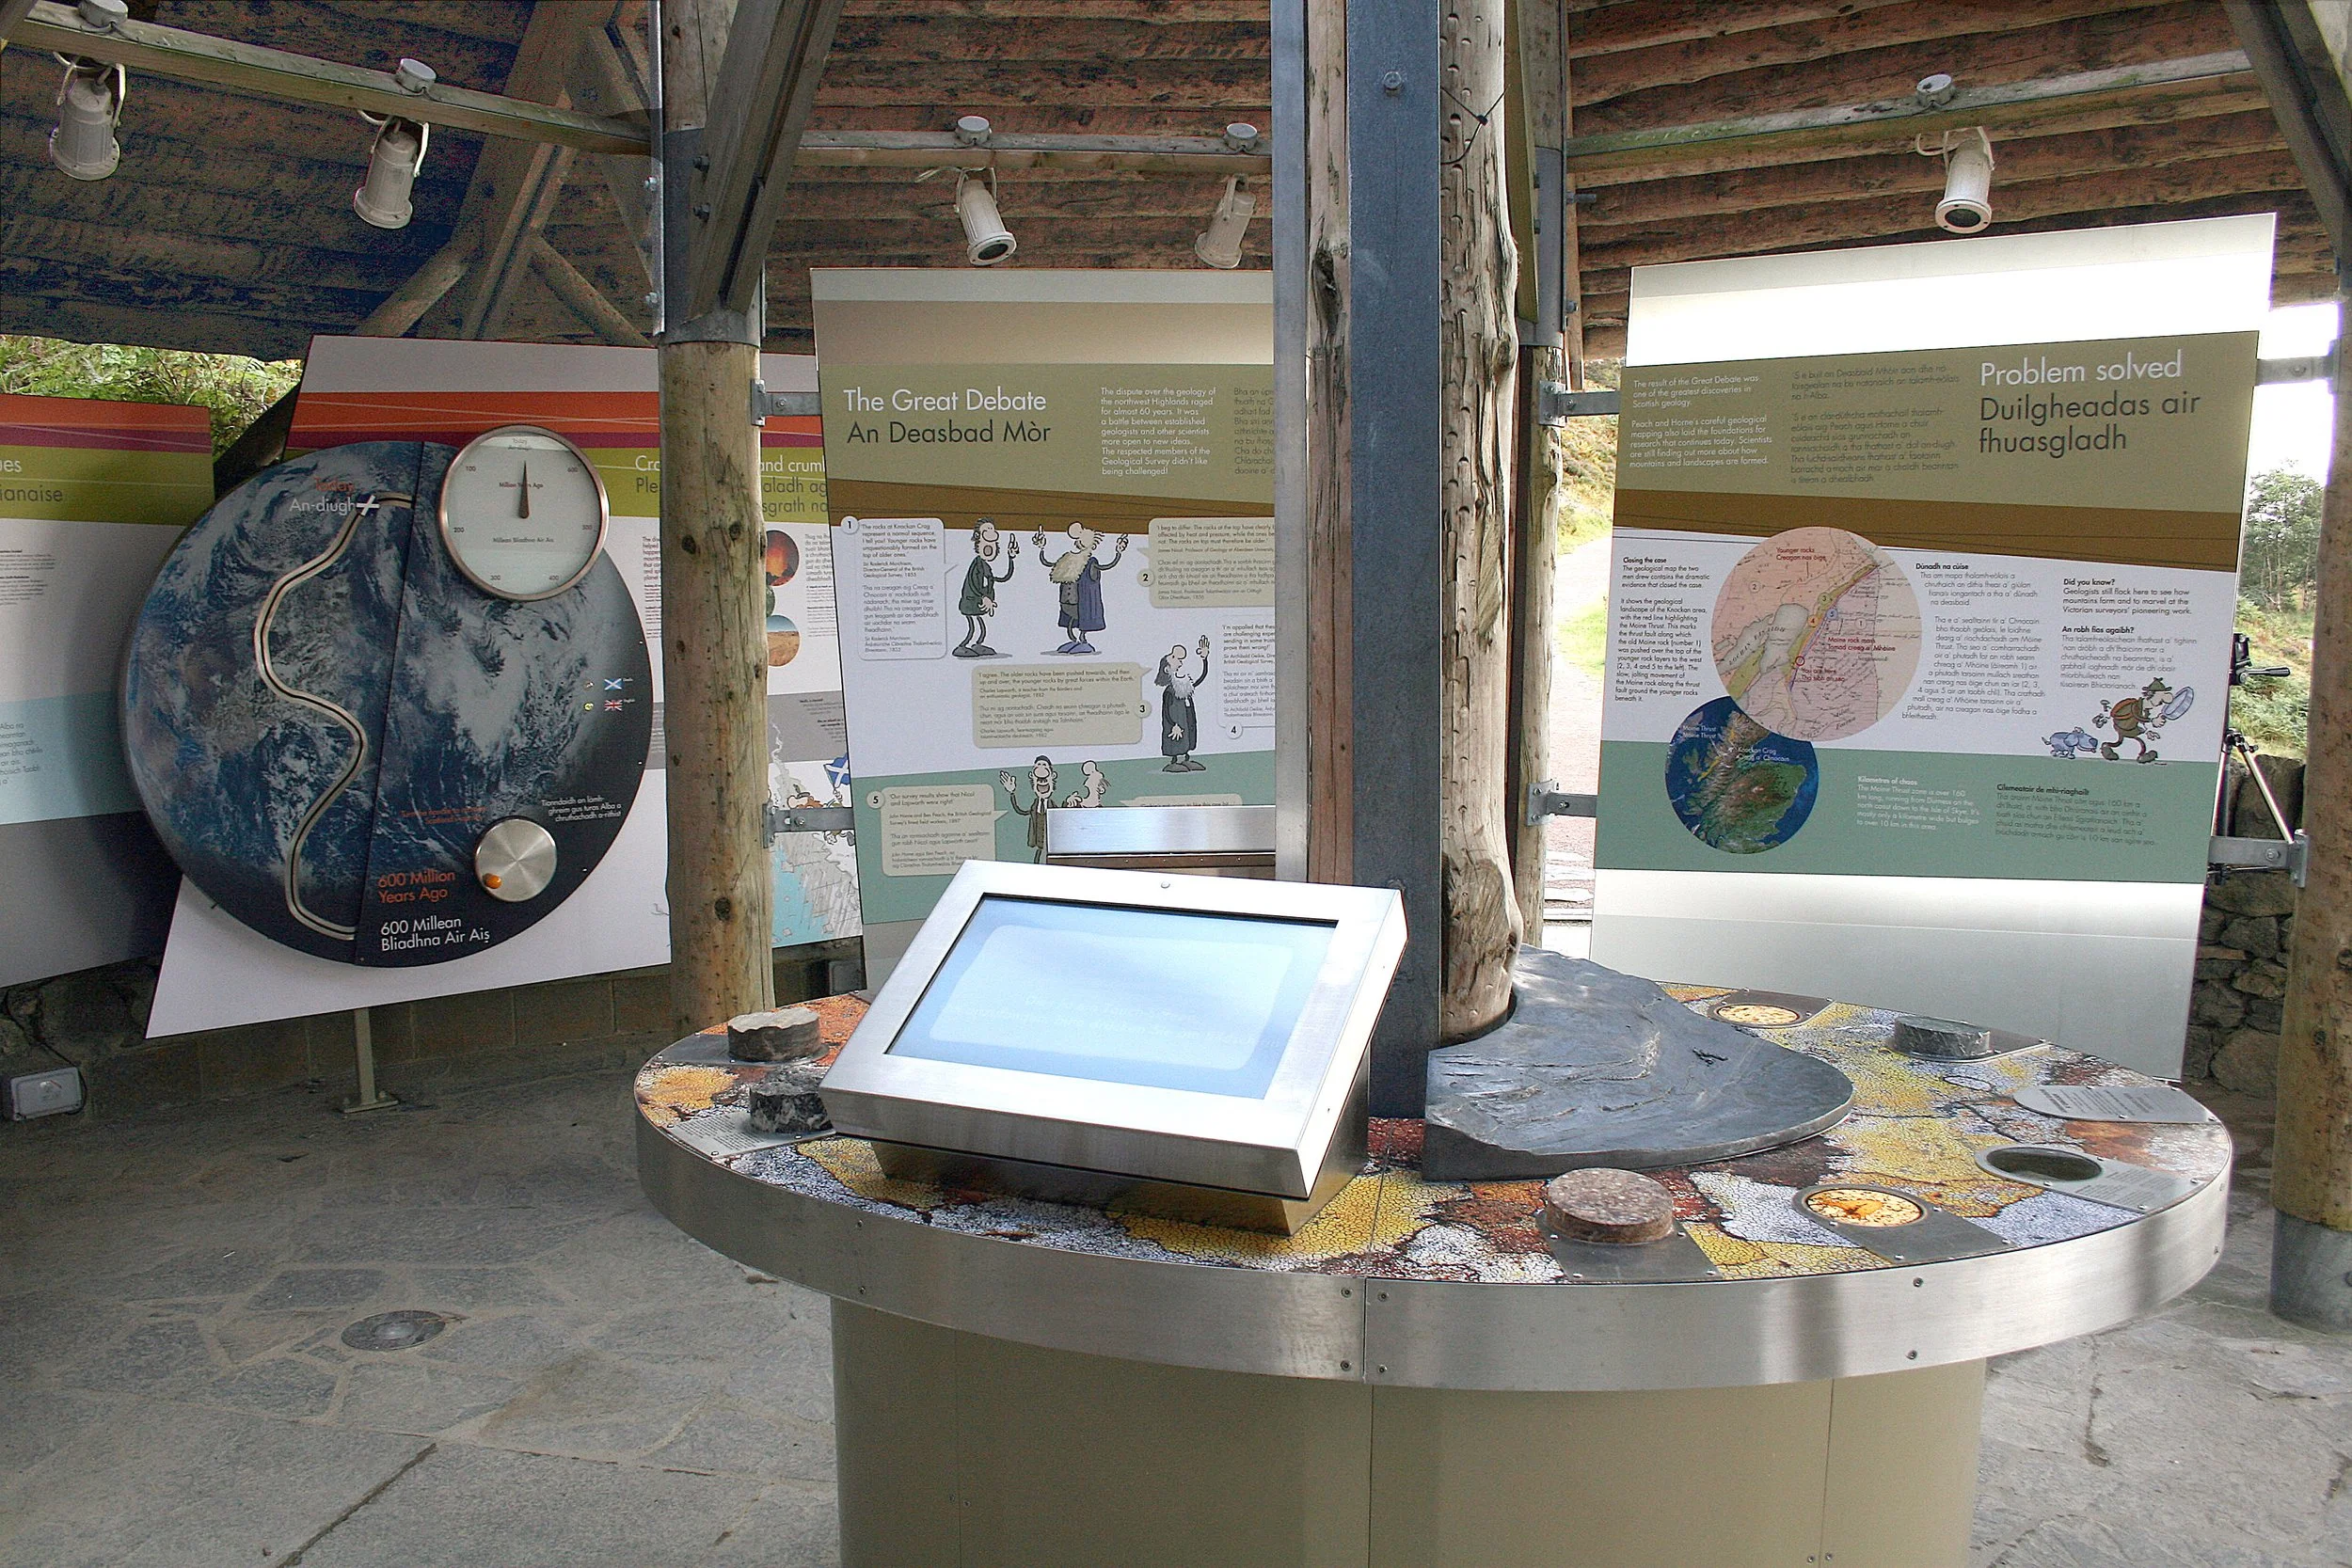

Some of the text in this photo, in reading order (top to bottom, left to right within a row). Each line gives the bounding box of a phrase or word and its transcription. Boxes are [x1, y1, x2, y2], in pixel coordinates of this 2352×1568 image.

[1981, 348, 2181, 386] Problem solved
[1648, 379, 1667, 387] result
[1691, 376, 1712, 385] Great
[1101, 388, 1113, 396] The
[1116, 388, 1143, 397] dispute
[1177, 388, 1205, 397] geology
[1670, 388, 1699, 397] greatest
[1701, 386, 1741, 395] discoveries
[844, 386, 1046, 411] The Great Debate
[1152, 397, 1188, 407] Highlands
[1191, 398, 1213, 407] raged
[1633, 399, 1660, 408] Scottish
[1981, 390, 2200, 427] Duilgheadas air
[1701, 416, 1725, 425] careful
[1728, 415, 1767, 426] geological
[847, 419, 1051, 443] An Deasbad Mòr
[1101, 428, 1138, 437] geologists
[1631, 430, 1662, 439] mapping
[1682, 428, 1695, 436] laid
[1711, 426, 1753, 435] foundations
[1122, 438, 1141, 446] open
[1678, 438, 1711, 446] continues
[1739, 436, 1772, 444] Scientists
[1979, 423, 2126, 458] fhuasgladh
[1117, 448, 1152, 457] respected
[1657, 449, 1682, 458] finding
[1102, 457, 1143, 466] Geological
[1145, 457, 1169, 466] Survey
[1629, 459, 1664, 468] mountains
[1683, 457, 1724, 467] landscapes
[1102, 467, 1168, 477] being challenged!
[314, 477, 354, 496] Today
[289, 498, 356, 515] An-diugh
[1231, 726, 1236, 734] 4
[378, 870, 455, 889] 600 Million
[380, 887, 448, 904] Years Ago
[381, 915, 461, 936] 600 Millean
[381, 931, 440, 952] Bliadhna
[445, 932, 465, 943] Air
